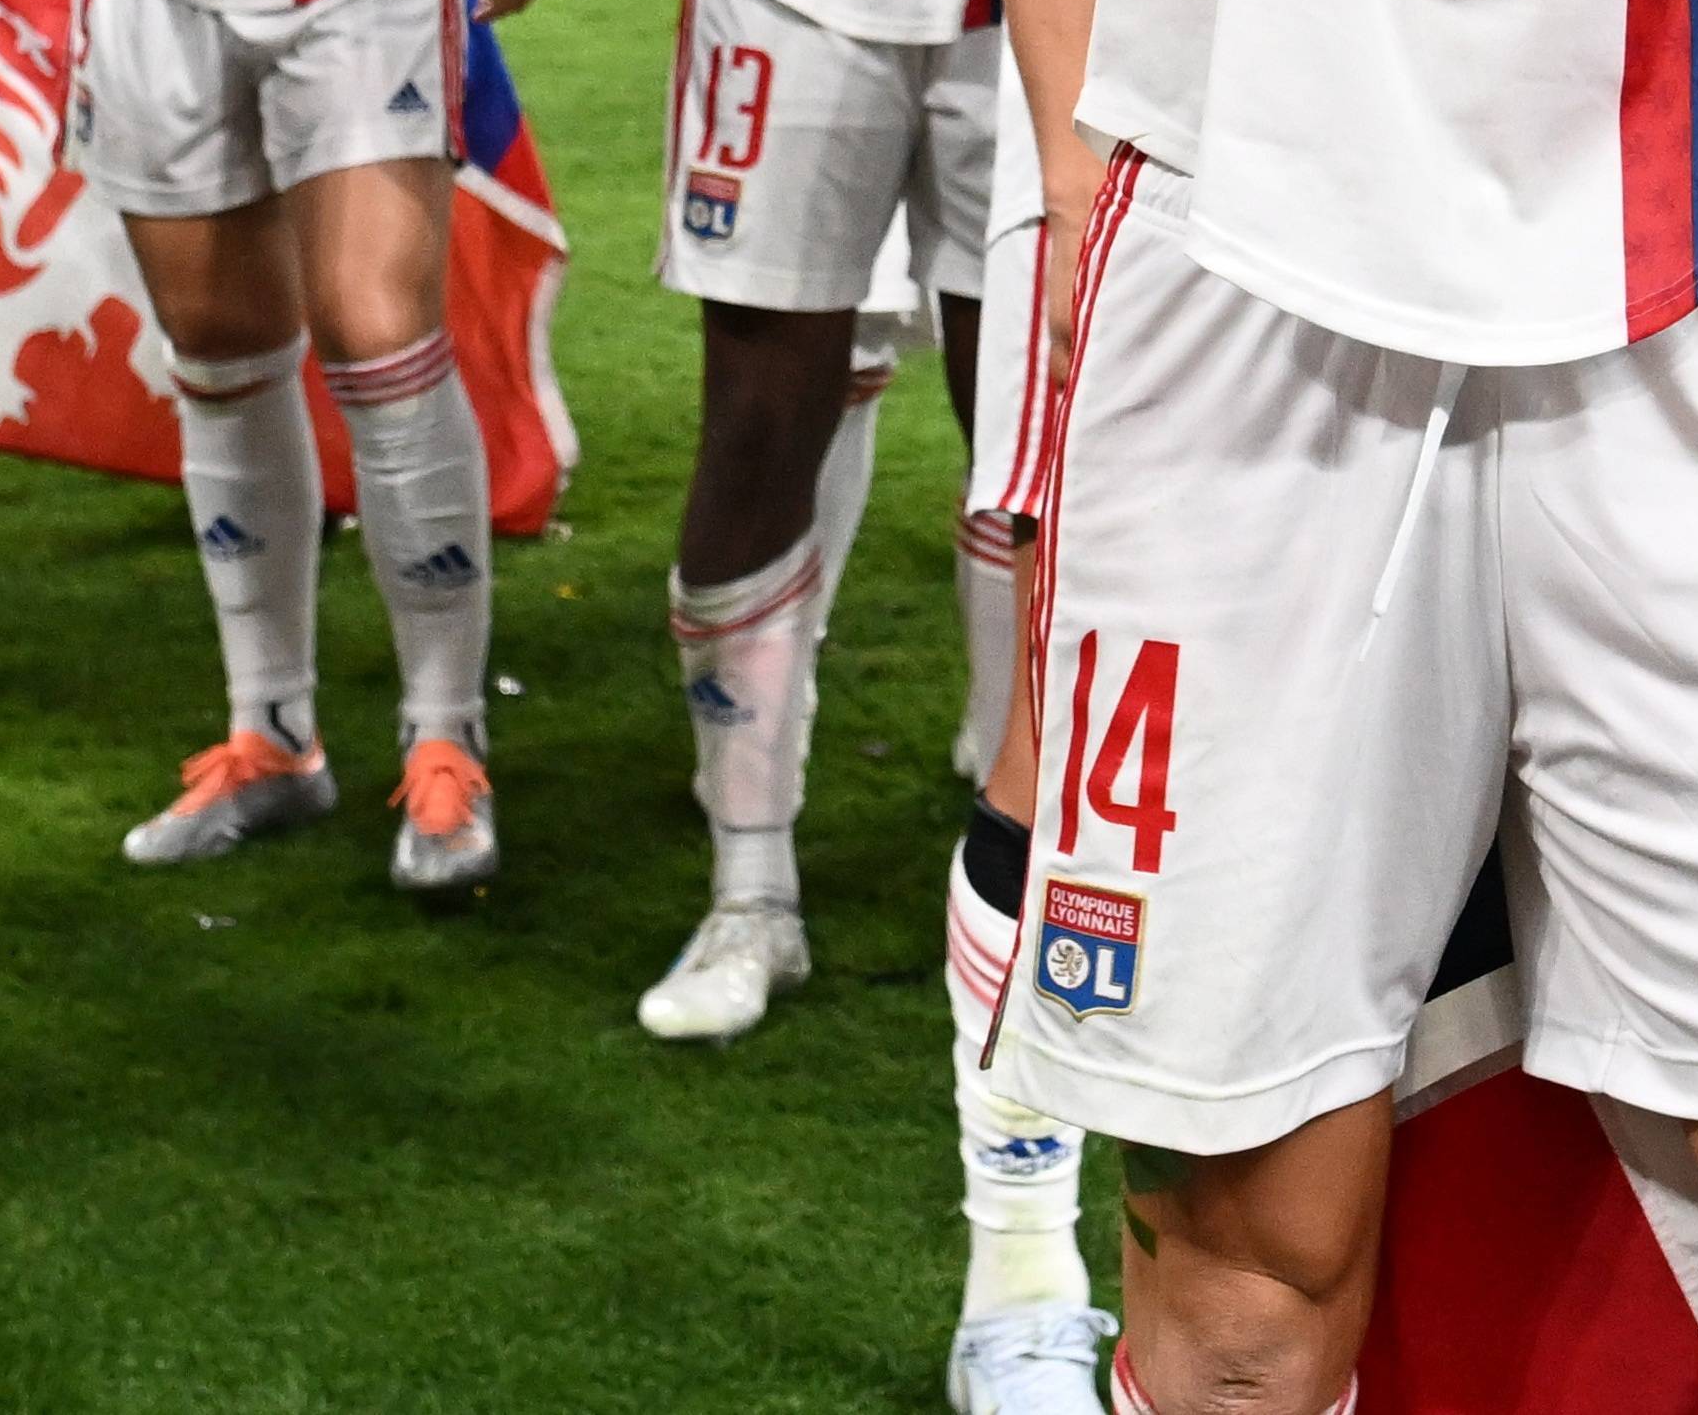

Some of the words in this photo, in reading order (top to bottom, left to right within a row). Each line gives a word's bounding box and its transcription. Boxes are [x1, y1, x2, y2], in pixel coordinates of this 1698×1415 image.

[696, 45, 776, 171] 13
[1058, 628, 1181, 874] 14
[1048, 900, 1136, 936] LYONNAIS
[1049, 887, 1136, 919] OLYMPIQUE
